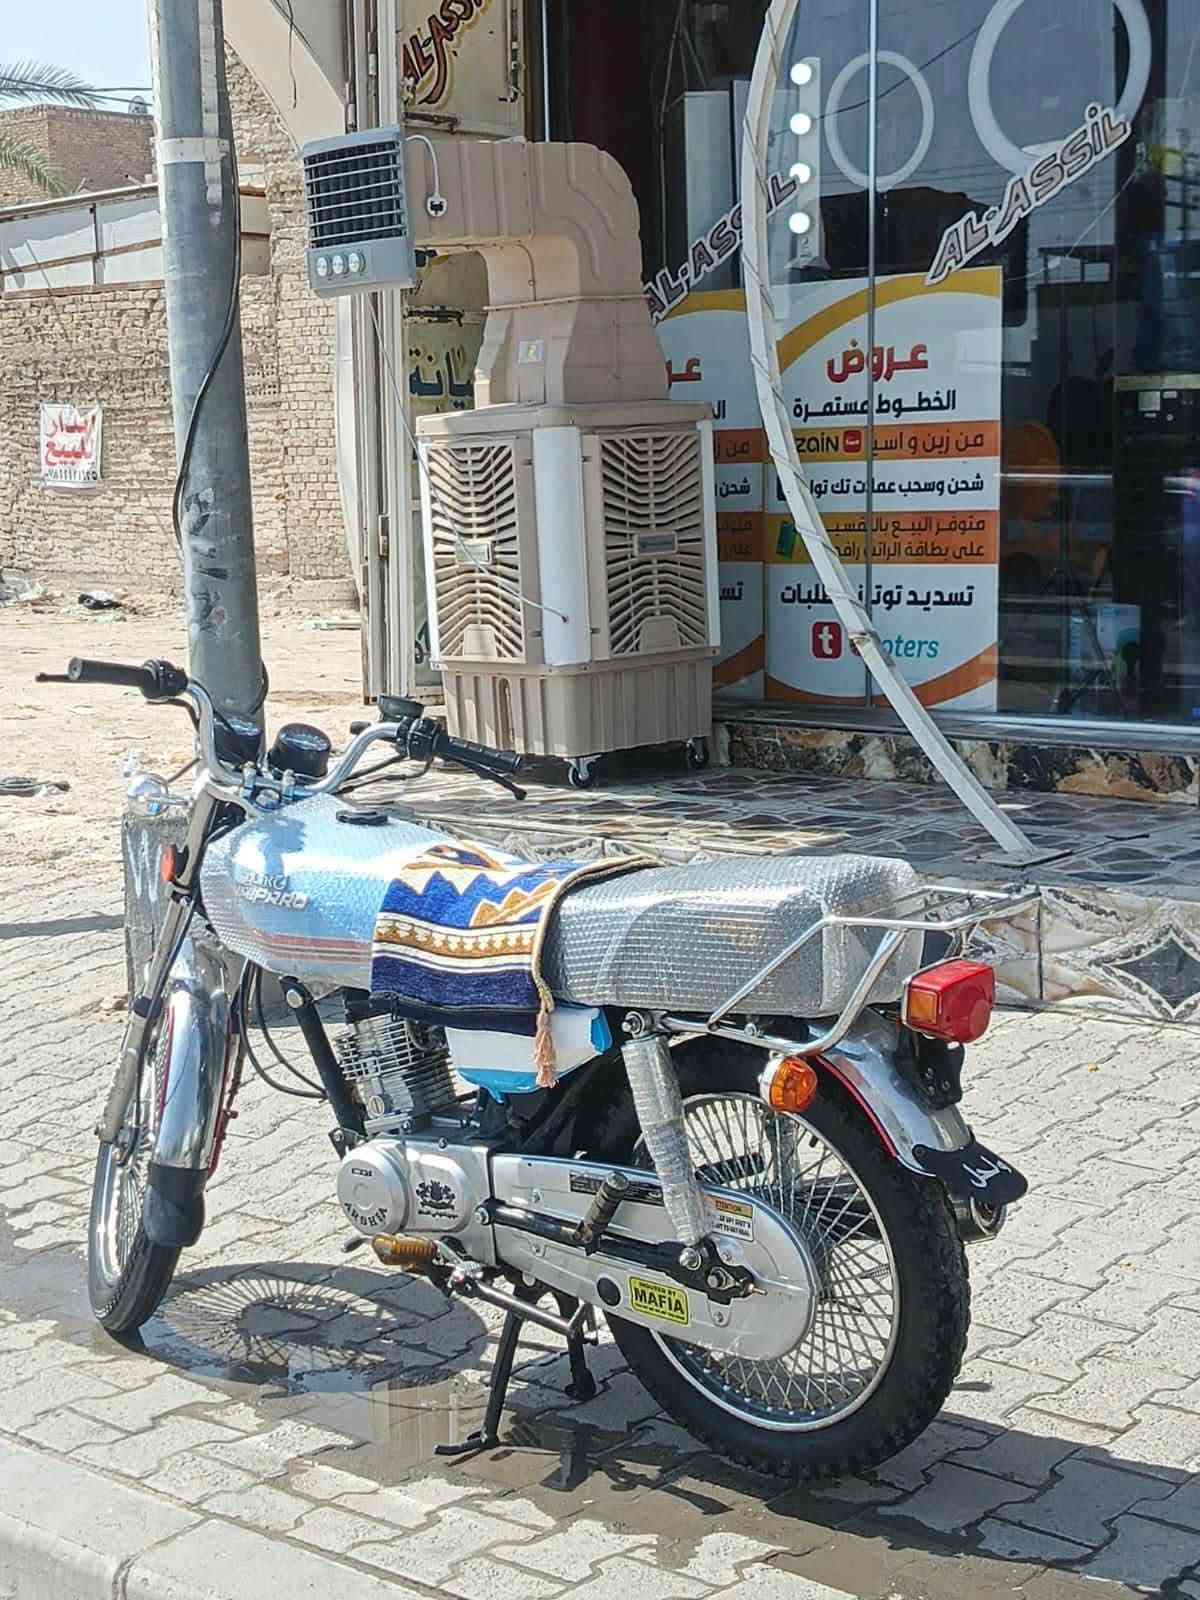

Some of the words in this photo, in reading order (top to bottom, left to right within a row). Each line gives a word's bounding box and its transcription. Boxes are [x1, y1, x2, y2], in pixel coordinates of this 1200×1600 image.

[793, 396, 870, 422] مستمرة
[876, 389, 956, 418] الخطوط
[908, 436, 917, 454] و
[922, 429, 950, 454] زين
[955, 432, 984, 449] من
[719, 477, 751, 497] شحن
[831, 478, 851, 494] تك
[899, 480, 944, 497] وسحب
[947, 473, 984, 496] شحن
[892, 515, 933, 538] البيع
[936, 516, 985, 536] متوفر
[904, 541, 950, 560] بطاقة
[953, 541, 985, 560] على
[907, 586, 975, 612] تسديد
[633, 1287, 685, 1315] MAFIA
